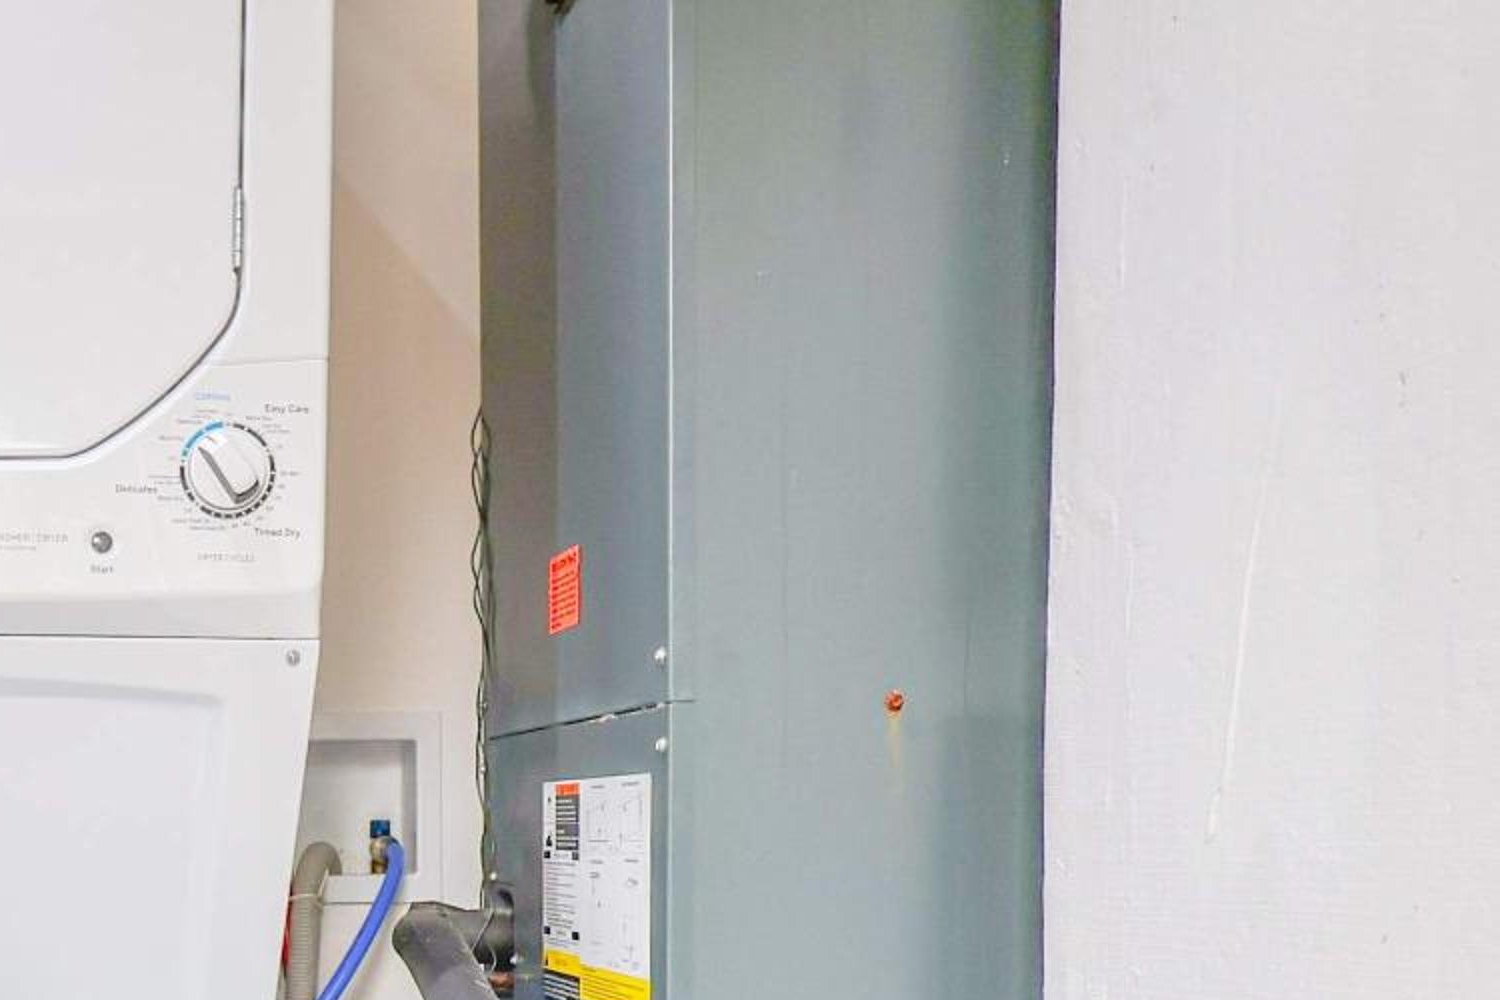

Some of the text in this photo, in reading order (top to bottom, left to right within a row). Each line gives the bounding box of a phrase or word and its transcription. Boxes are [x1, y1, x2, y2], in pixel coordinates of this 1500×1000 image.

[264, 403, 286, 416] Easy
[115, 483, 158, 494] Delicates
[254, 527, 301, 541] Timed Dry
[90, 564, 114, 574] Start
